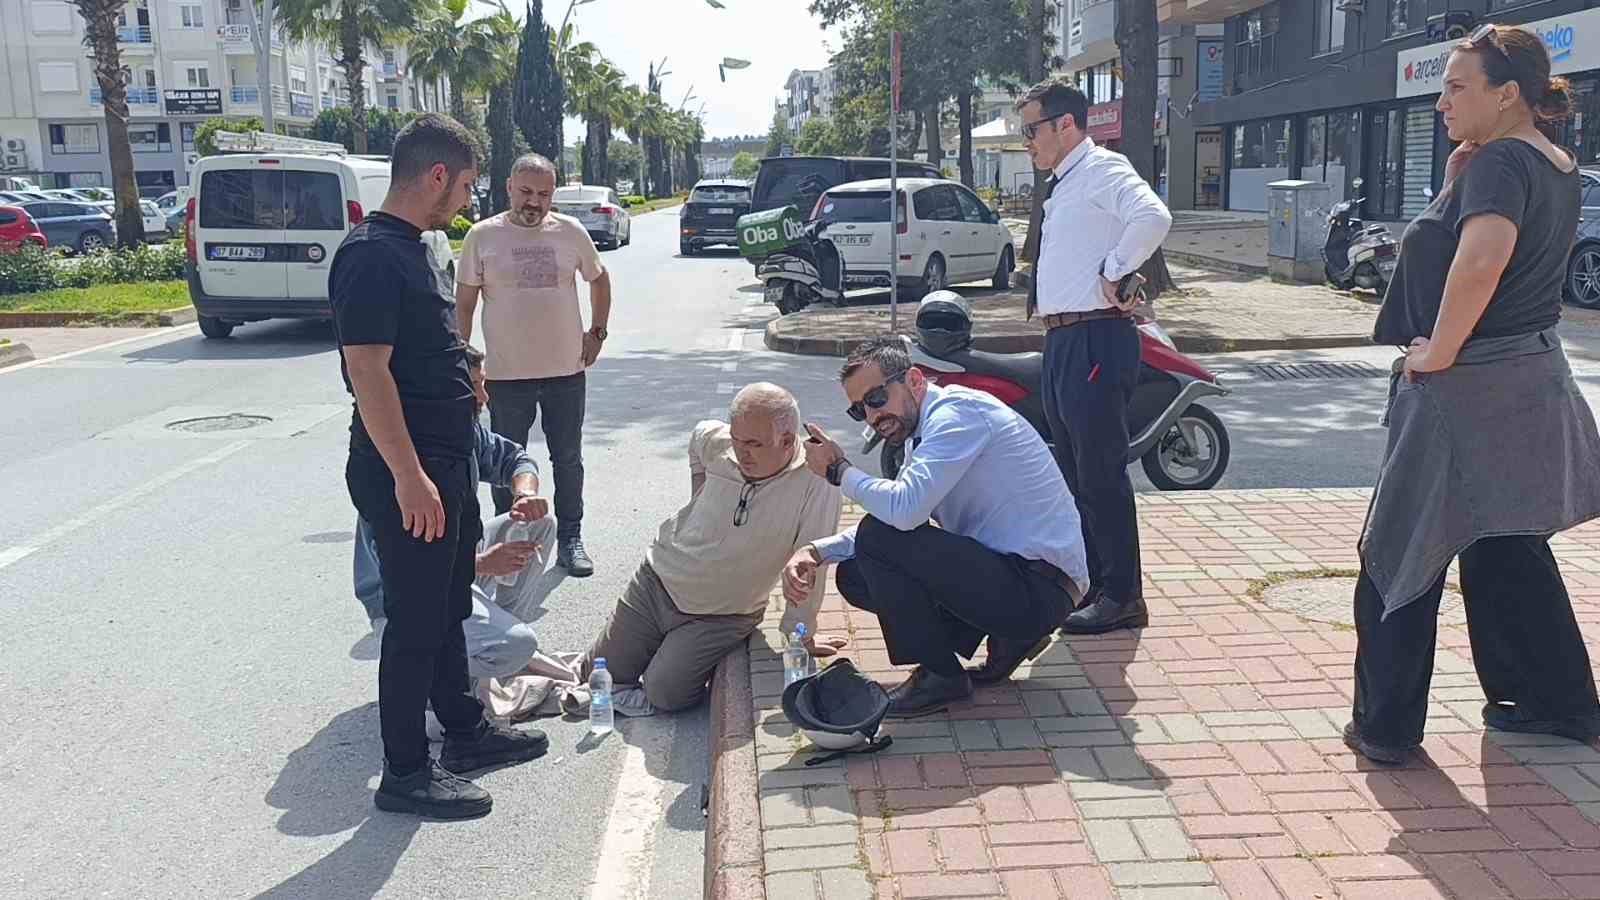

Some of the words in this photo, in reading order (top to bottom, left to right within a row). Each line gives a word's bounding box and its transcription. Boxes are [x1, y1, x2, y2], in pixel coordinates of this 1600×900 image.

[1414, 51, 1449, 84] arçeli
[743, 226, 779, 245] Oba
[783, 216, 806, 241] Oba
